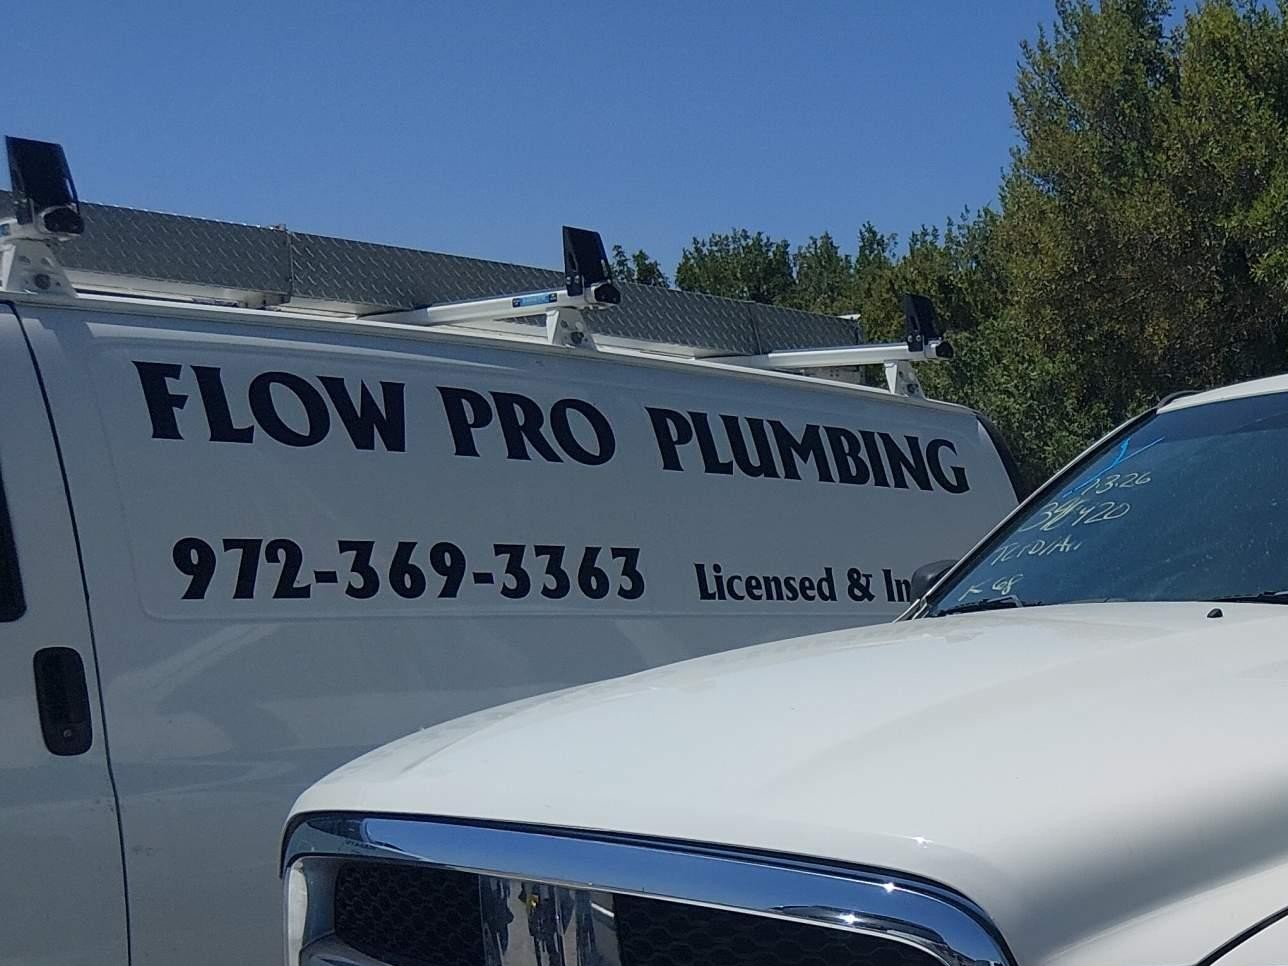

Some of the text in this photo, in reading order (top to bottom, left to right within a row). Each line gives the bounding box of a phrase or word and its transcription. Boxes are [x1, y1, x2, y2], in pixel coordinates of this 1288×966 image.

[131, 361, 970, 495] FLOW PRO PLUMBING
[173, 537, 645, 600] 972-369-3363
[694, 563, 838, 601] Licensed
[847, 567, 876, 602] &
